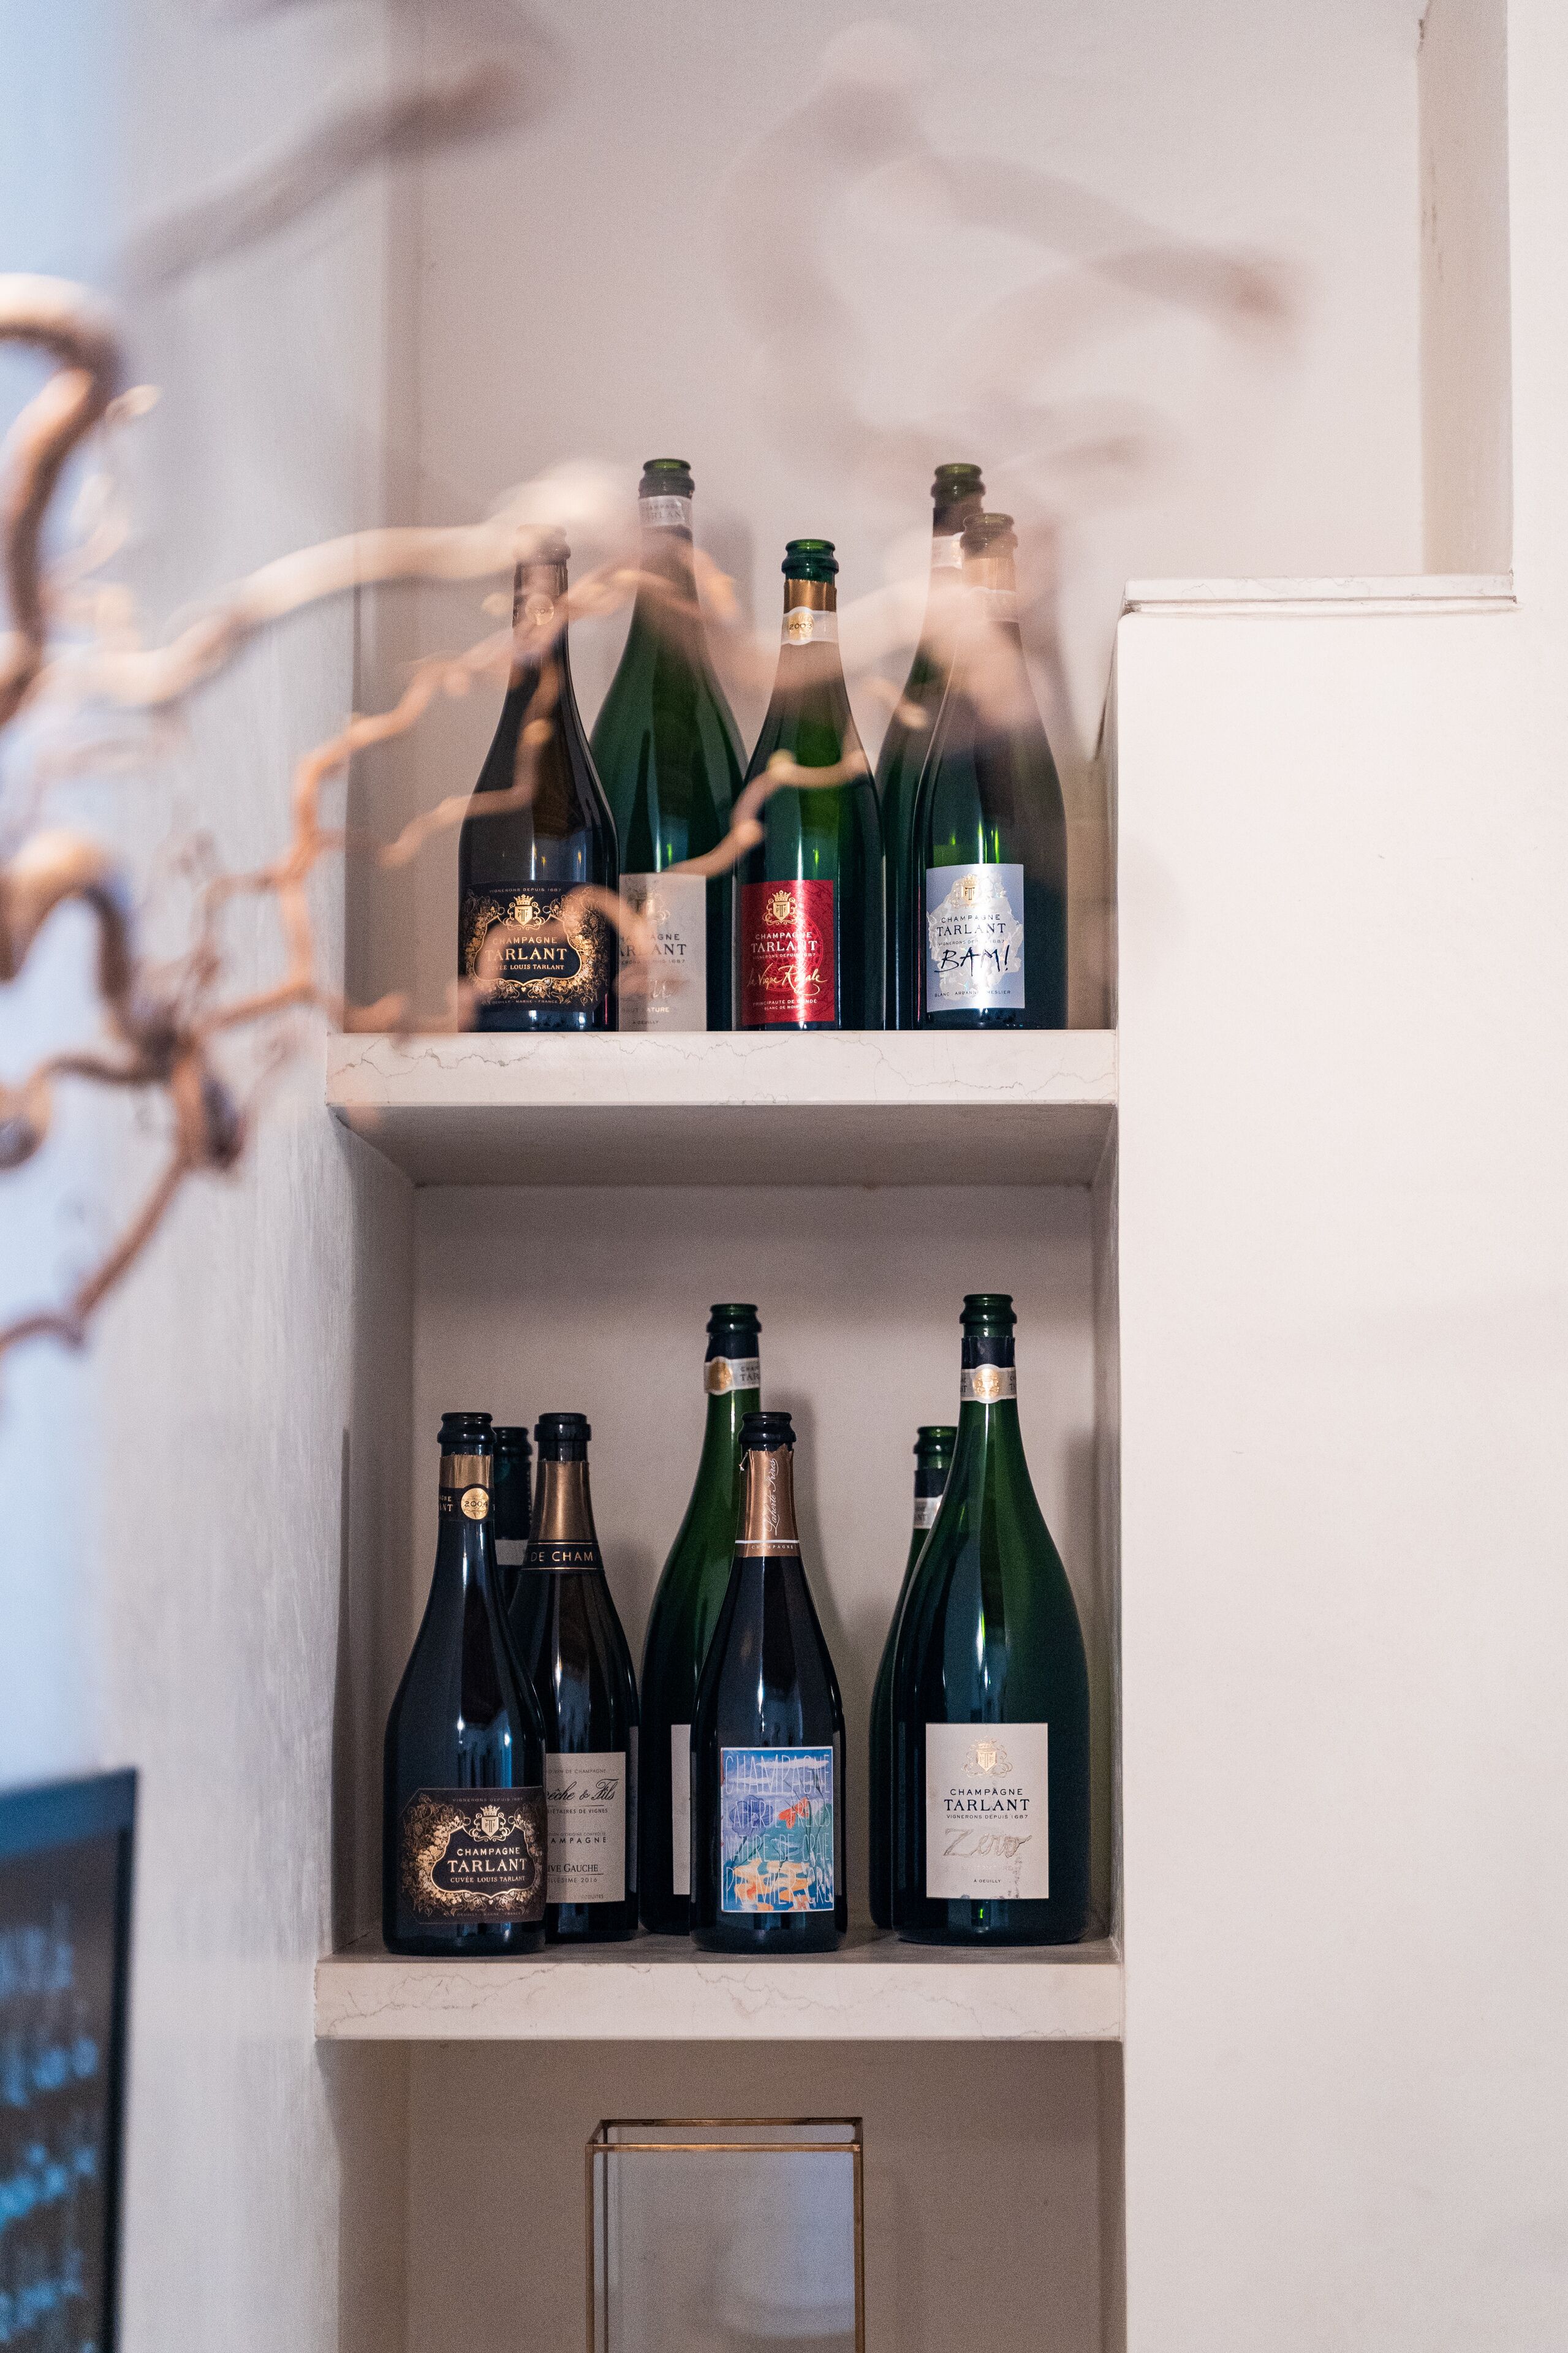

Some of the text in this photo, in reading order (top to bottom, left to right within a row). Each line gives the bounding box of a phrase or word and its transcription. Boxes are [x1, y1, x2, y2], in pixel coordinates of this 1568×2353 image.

[941, 914, 1001, 923] CHAMPAGNE
[936, 923, 1006, 937] TARLANT
[492, 936, 558, 945] CHAMPAGNE
[751, 941, 817, 953] TARLANT
[485, 947, 567, 961] TARLANT
[934, 944, 1010, 977] BAM!
[778, 964, 828, 996] Rale
[530, 1552, 545, 1562] DE
[725, 1754, 831, 1795] CHAMPAGNE
[578, 1789, 591, 1800] &
[591, 1778, 619, 1801] Fils
[944, 1799, 1030, 1811] TARLANT
[725, 1799, 782, 1828] LAHERTE
[725, 1833, 830, 1864] NATURE DE CRAIE
[943, 1828, 1032, 1859] Zero
[456, 1847, 520, 1857] CHAMPAGNE
[447, 1859, 527, 1873] TARLANT
[547, 1864, 561, 1873] IVE
[726, 1866, 832, 1906] PREMIER CRU
